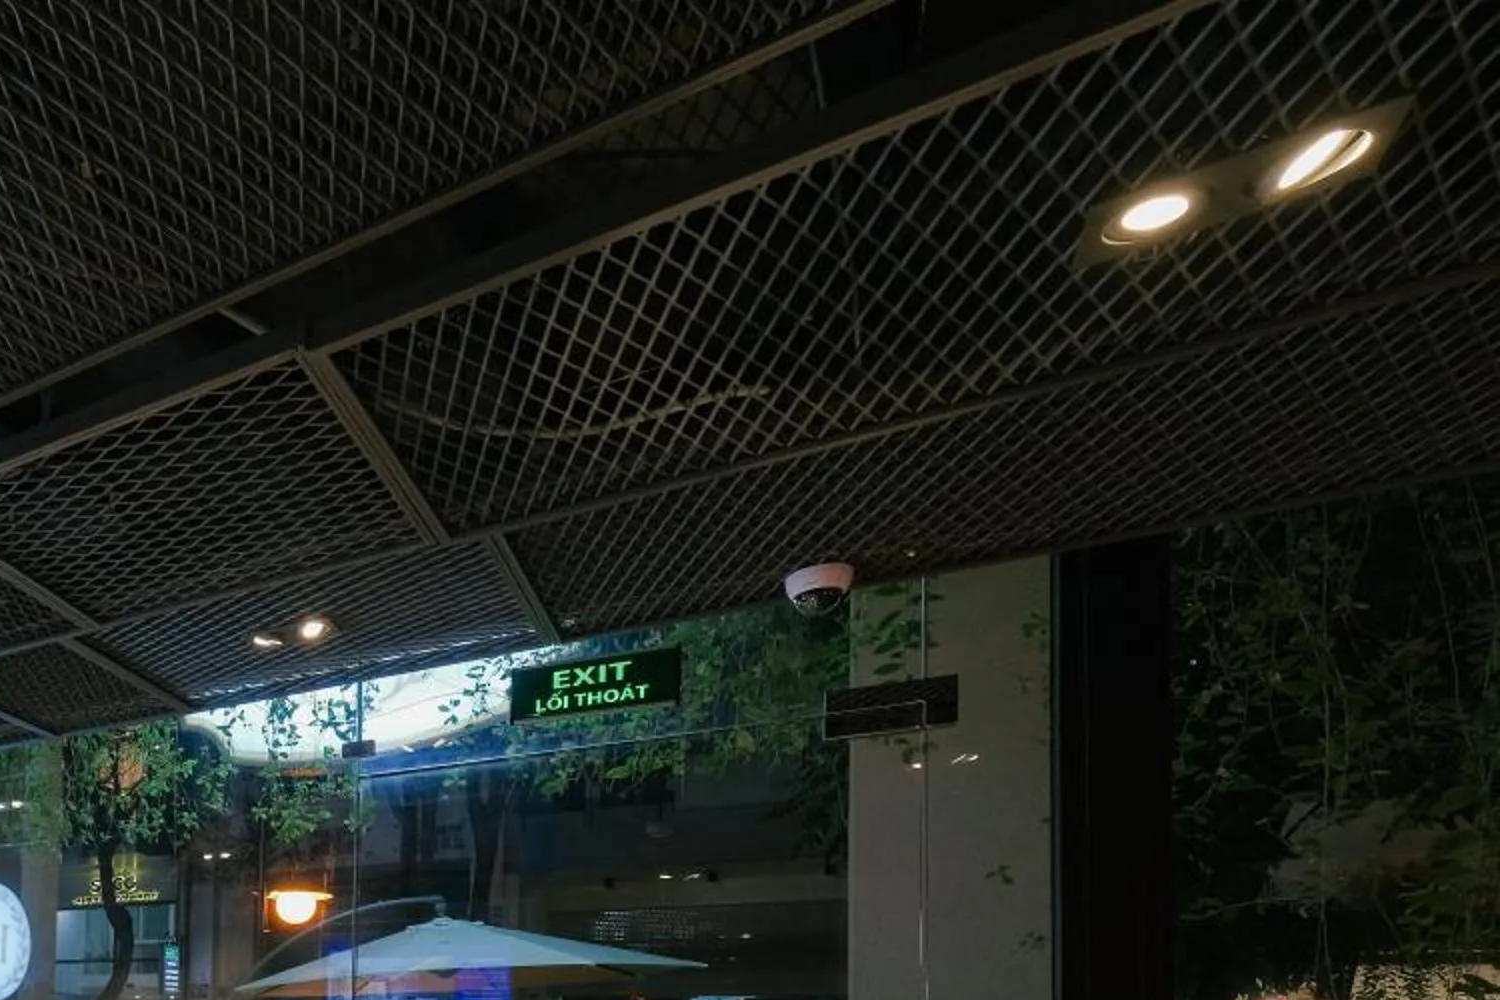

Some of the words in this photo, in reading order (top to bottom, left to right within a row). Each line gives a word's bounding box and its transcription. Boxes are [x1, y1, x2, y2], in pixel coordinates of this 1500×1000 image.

[552, 661, 633, 690] EXIT
[535, 690, 569, 714] LỐI
[574, 683, 650, 708] THOÁT
